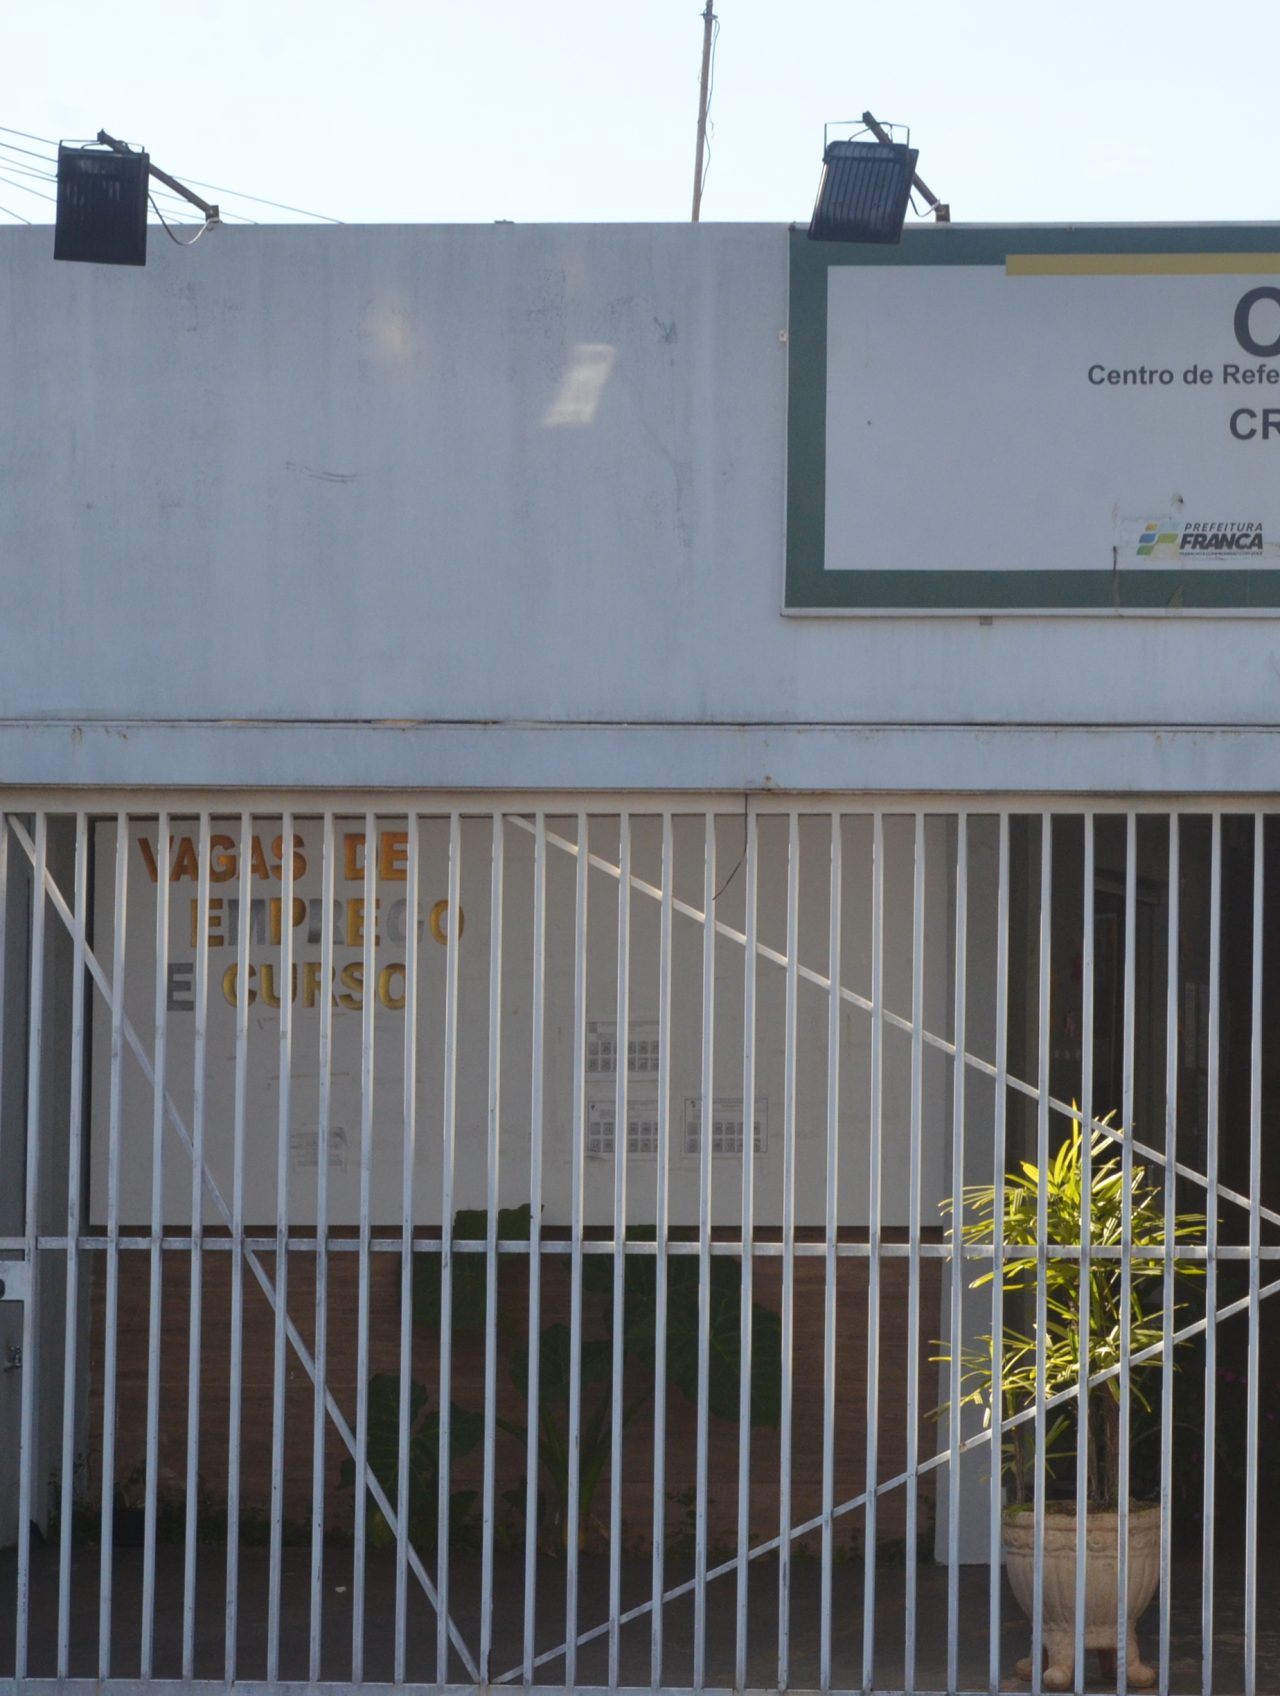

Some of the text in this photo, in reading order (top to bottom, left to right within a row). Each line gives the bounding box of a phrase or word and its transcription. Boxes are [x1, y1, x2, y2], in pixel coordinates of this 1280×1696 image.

[1087, 364, 1174, 385] Centro
[1183, 363, 1213, 385] de
[1179, 533, 1264, 550] FRANCA
[1183, 523, 1263, 532] PREFEITURA
[138, 831, 409, 883] VAGAS DE
[191, 897, 465, 948] EMPREGO
[166, 961, 409, 1012] E CURSO
